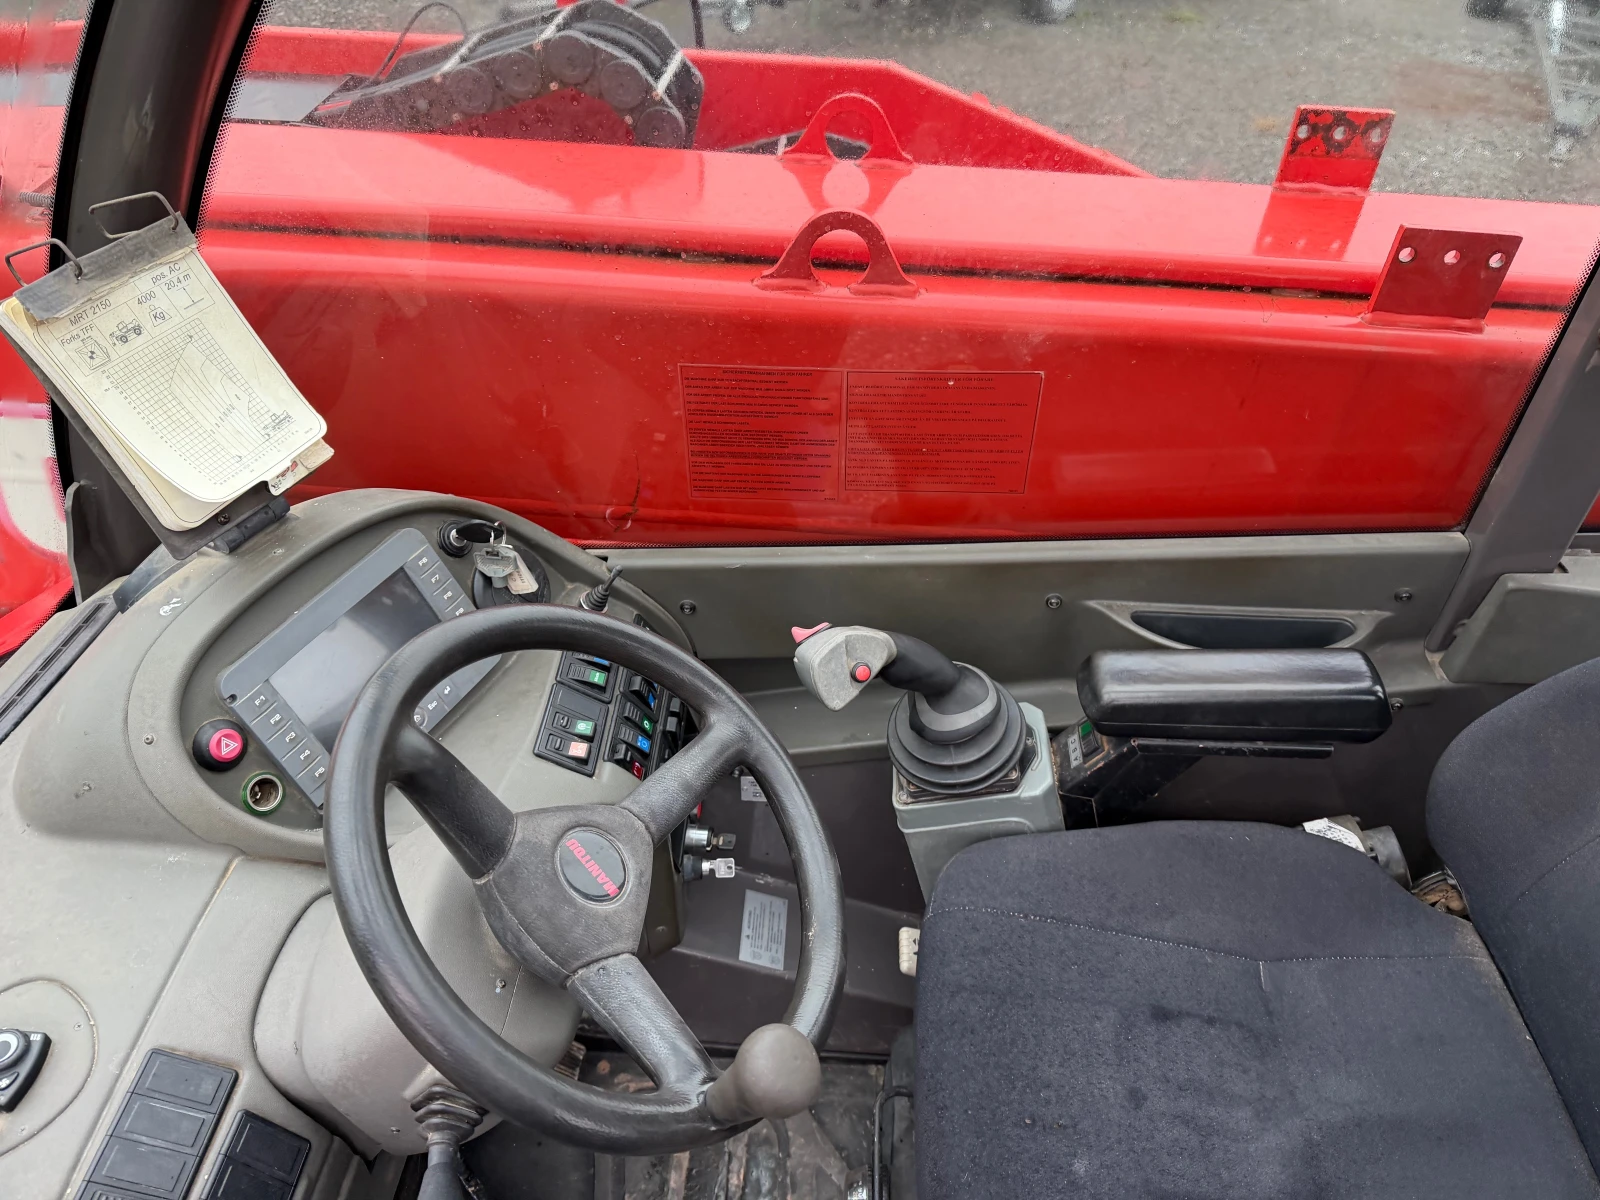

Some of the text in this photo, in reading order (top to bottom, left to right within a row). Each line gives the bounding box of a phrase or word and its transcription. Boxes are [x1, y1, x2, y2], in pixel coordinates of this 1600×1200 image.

[150, 262, 181, 285] pos. AC
[164, 273, 192, 291] 20,4 m
[137, 290, 157, 306] 4000
[68, 298, 112, 327] MRT 2150
[152, 311, 166, 323] Kg
[60, 332, 80, 347] Forks
[79, 323, 95, 337] TFF
[418, 556, 428, 567] F6
[431, 573, 440, 584] F7
[254, 695, 266, 706] F1
[427, 700, 438, 711] Esc
[269, 713, 282, 725] F2
[285, 731, 296, 743] F3
[299, 749, 311, 761] F4
[565, 838, 620, 898] MANITOU
